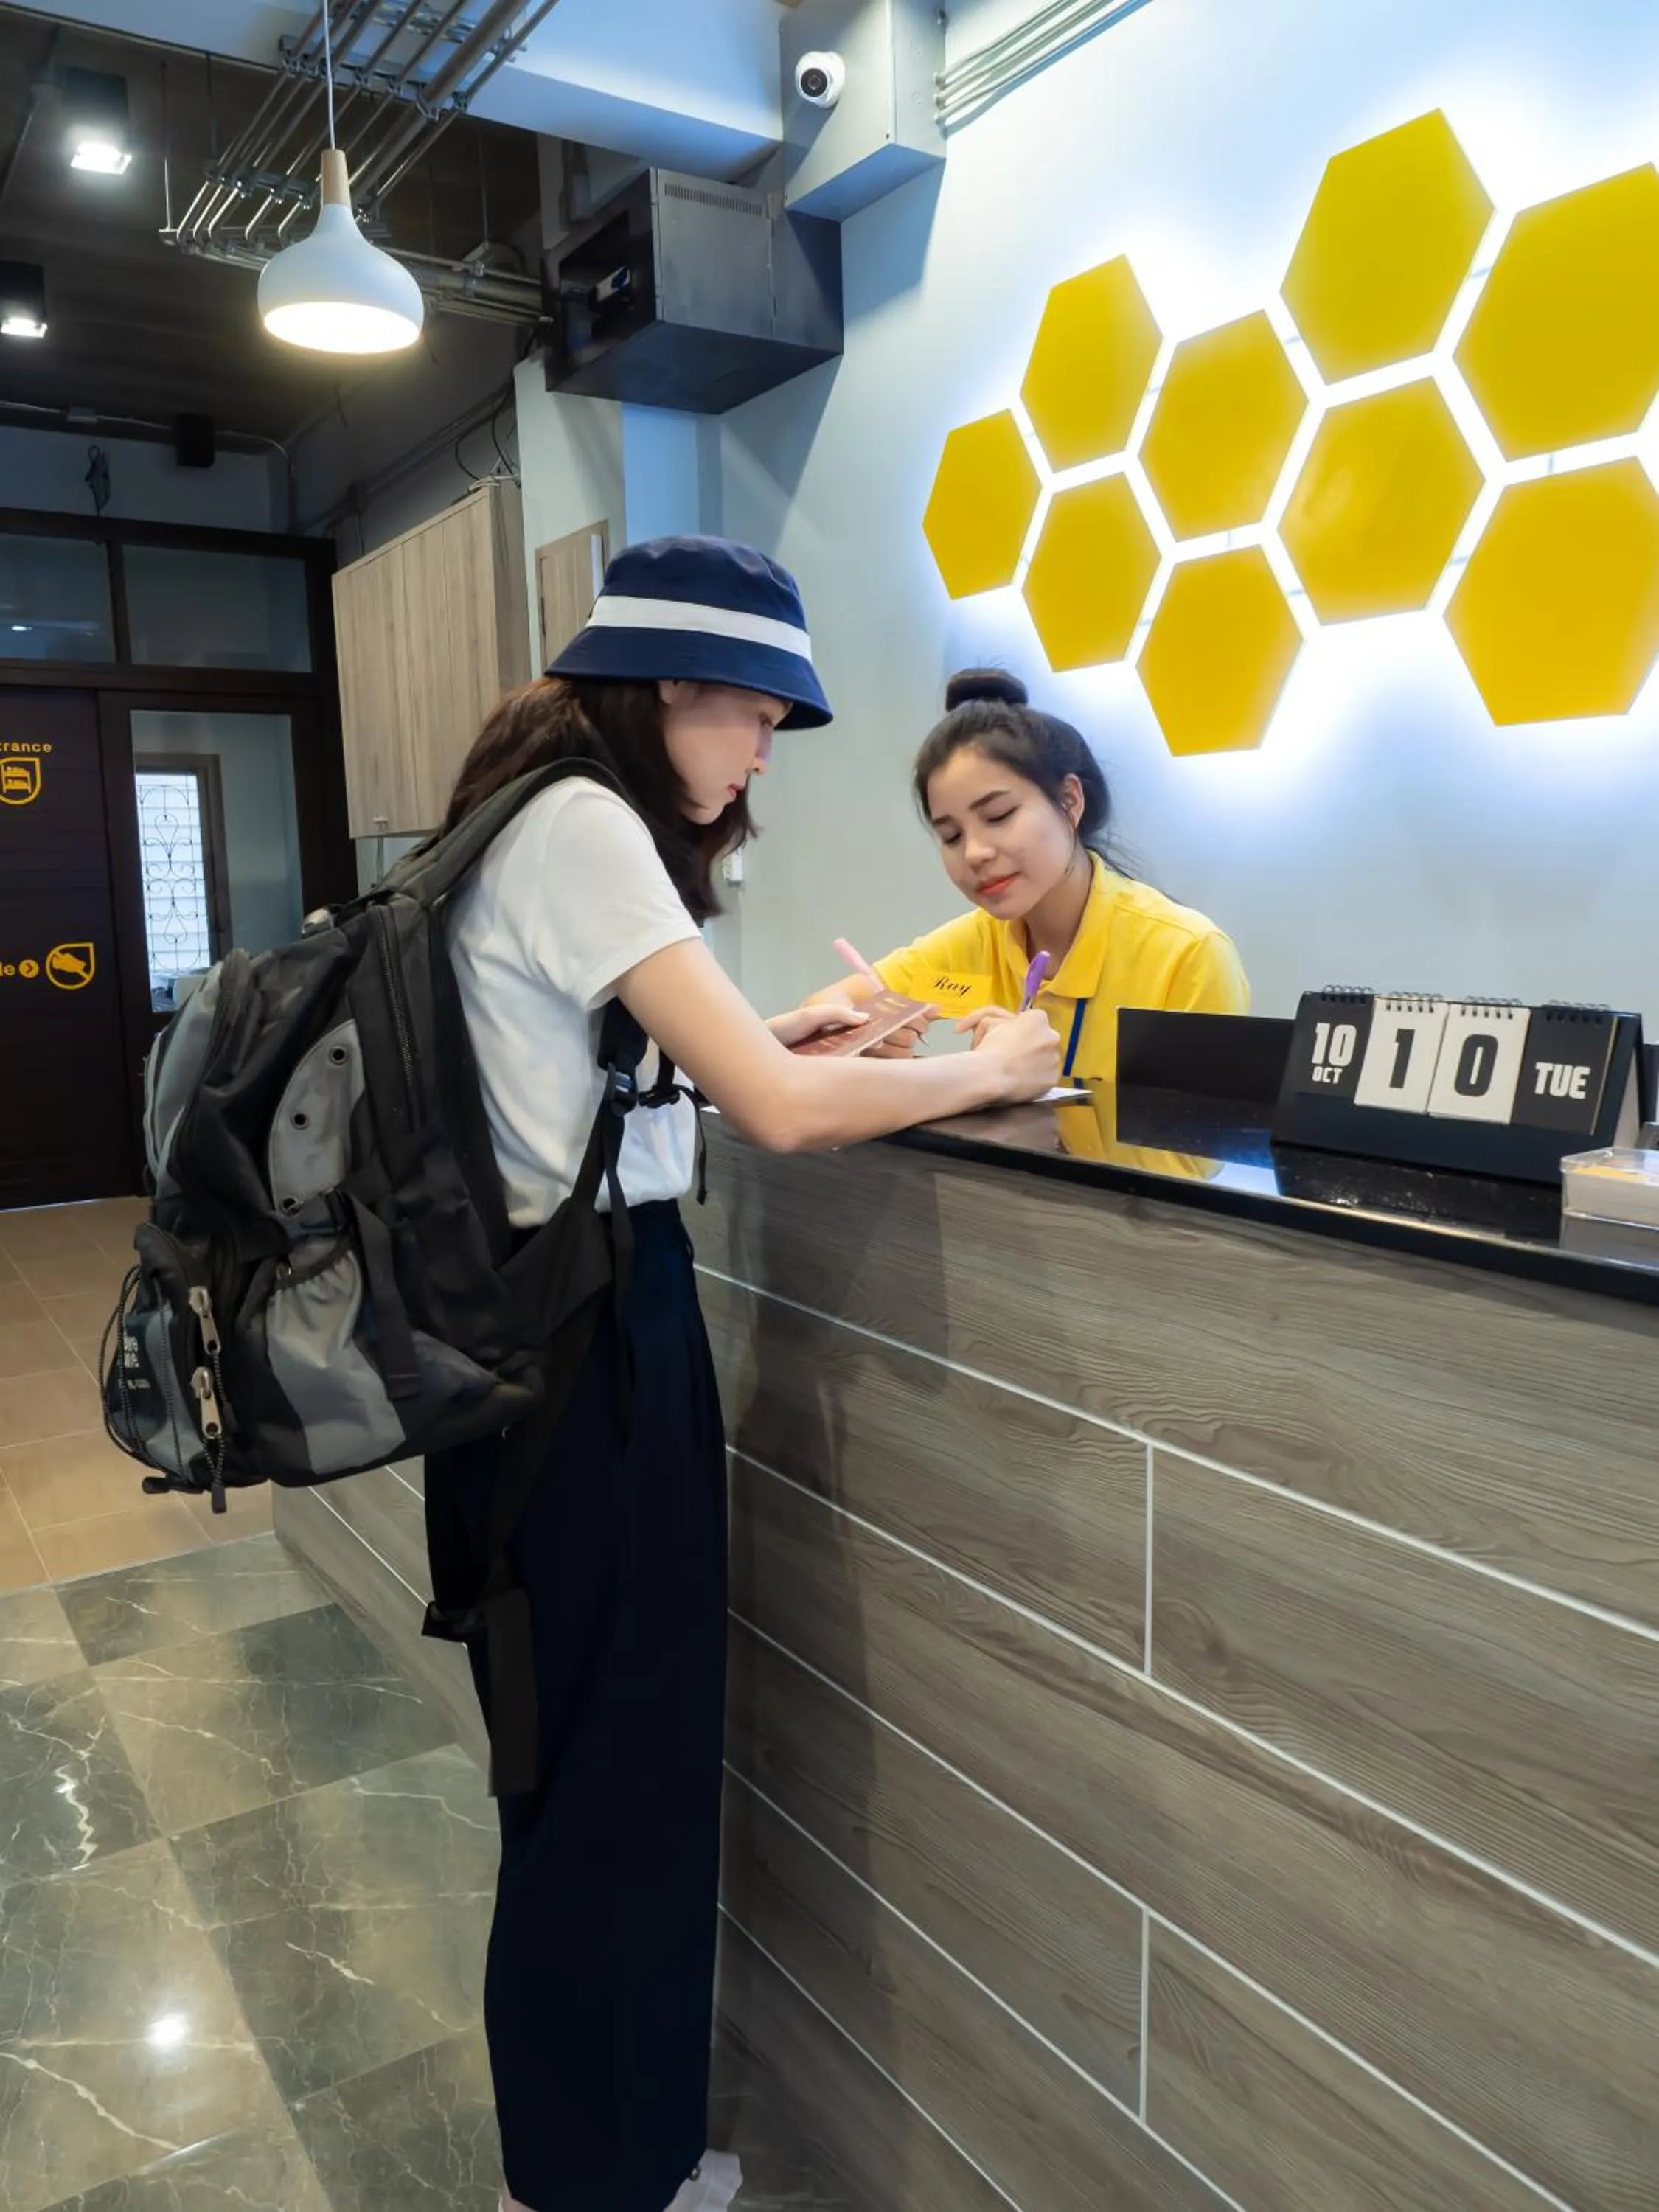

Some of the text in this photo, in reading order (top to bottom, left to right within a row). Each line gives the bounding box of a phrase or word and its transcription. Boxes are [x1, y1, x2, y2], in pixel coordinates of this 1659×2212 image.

[1312, 1023, 1357, 1067] 10
[1312, 1065, 1343, 1084] OCT
[1534, 1062, 1590, 1099] TUE
